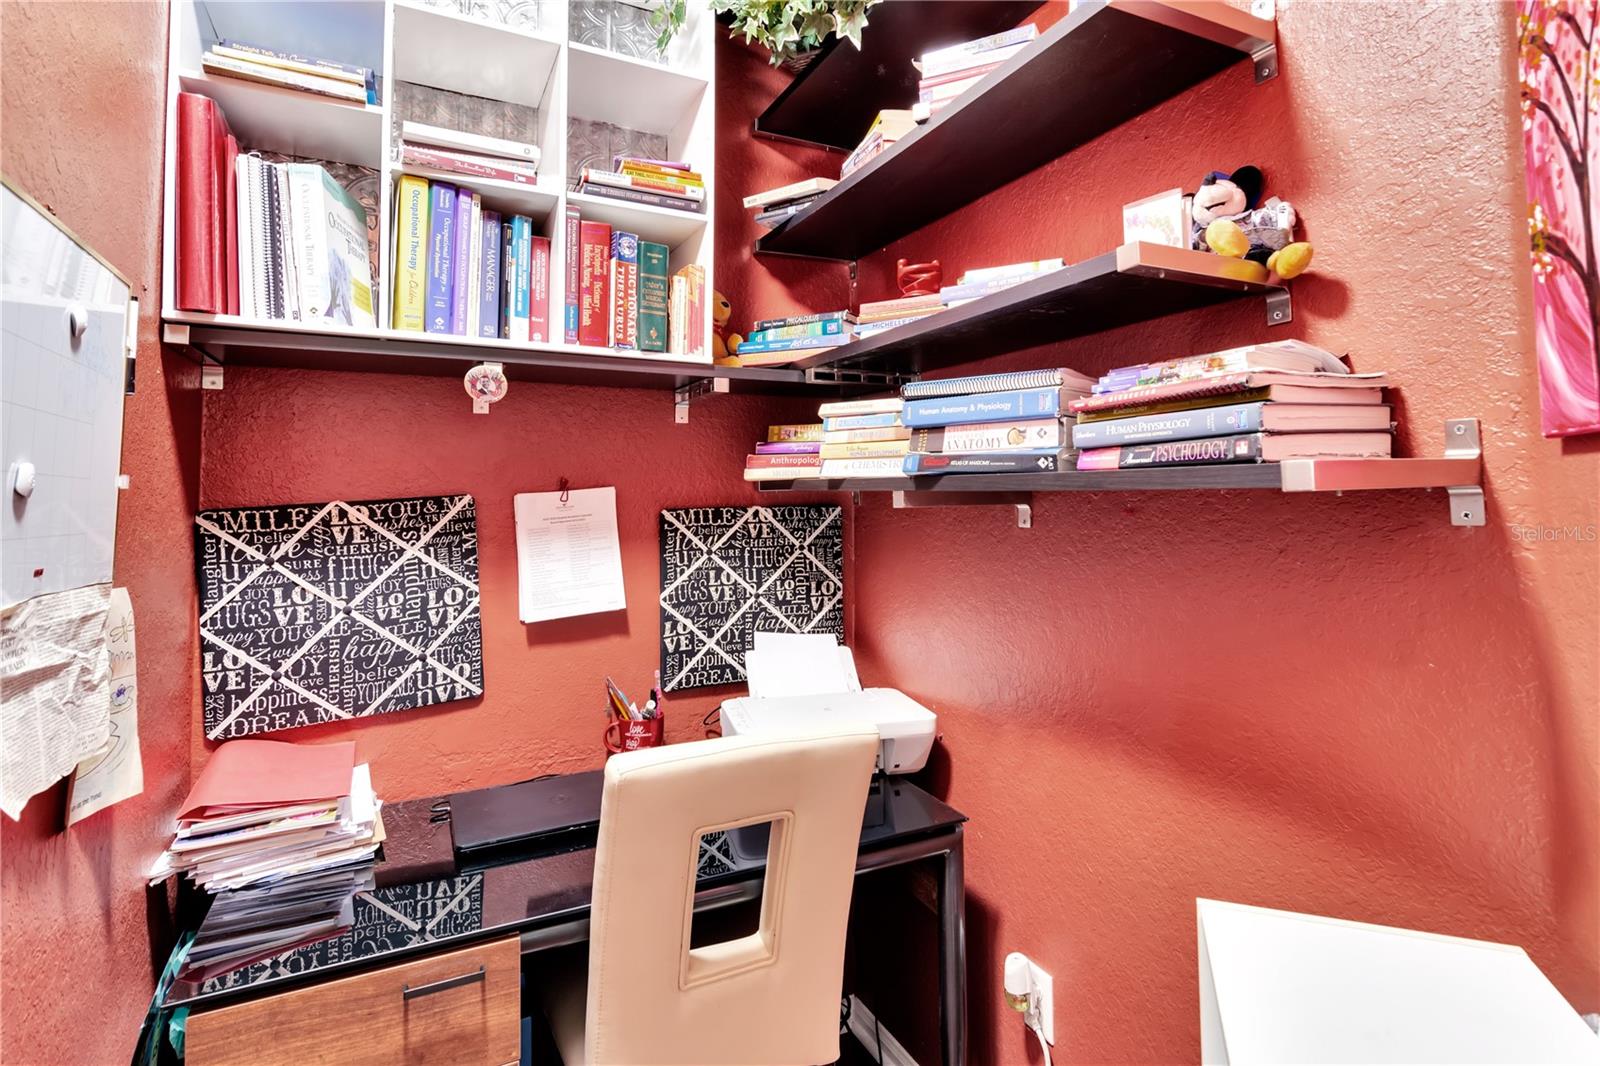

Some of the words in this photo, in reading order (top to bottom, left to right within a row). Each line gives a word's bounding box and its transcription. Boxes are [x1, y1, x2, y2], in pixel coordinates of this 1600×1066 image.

[410, 189, 421, 239] Occupational
[442, 217, 451, 258] Occupational
[408, 241, 419, 271] Therapy
[592, 244, 603, 276] Encyclopedia
[440, 259, 449, 286] Therapy
[485, 248, 496, 293] MANAGER
[583, 293, 592, 309] Allied
[592, 281, 602, 308] Dictionary
[616, 266, 625, 340] THESAURUS
[627, 264, 637, 344] DICTIONARY
[582, 309, 592, 326] Health
[919, 407, 940, 416] Human
[941, 405, 968, 415] Anatomy
[977, 401, 1012, 412] Physiology
[1106, 424, 1138, 436] HUMAN
[1138, 418, 1191, 432] PHYSIOLOGY
[946, 437, 1002, 450] ANATOMY
[1155, 439, 1228, 462] PSYCHOLOGY
[771, 457, 823, 466] Anthropology
[199, 507, 309, 534] SMILE
[368, 500, 423, 520] YOU
[423, 500, 440, 514] &
[664, 507, 735, 530] SMILE
[772, 506, 808, 520] YOU
[808, 508, 819, 518] &
[698, 526, 733, 535] believ
[324, 541, 401, 556] CHERISH
[742, 537, 792, 548] CHERISH
[664, 531, 675, 584] laughter
[689, 550, 741, 558] TRSURE
[752, 546, 791, 568] HUGS
[203, 537, 219, 603] laughter
[242, 559, 322, 573] TRSURE
[340, 551, 399, 581] HUGS
[400, 530, 426, 622] happinss
[691, 569, 708, 580] JOY
[244, 588, 271, 600] JOY
[375, 578, 404, 594] JOY
[426, 576, 452, 591] HUGS
[206, 599, 271, 630] HUGS
[698, 600, 729, 615] YOU
[728, 601, 738, 613] &
[255, 625, 303, 645] YOU
[303, 625, 316, 639] &
[745, 613, 753, 650] ERISH
[273, 641, 328, 658] wises
[328, 639, 340, 705] CHERISH
[355, 664, 409, 682] believ
[471, 639, 481, 696] HERISH
[680, 668, 748, 689] DREAM
[340, 659, 356, 715] aughter
[205, 695, 214, 734] elieve
[226, 707, 340, 738] DREAM
